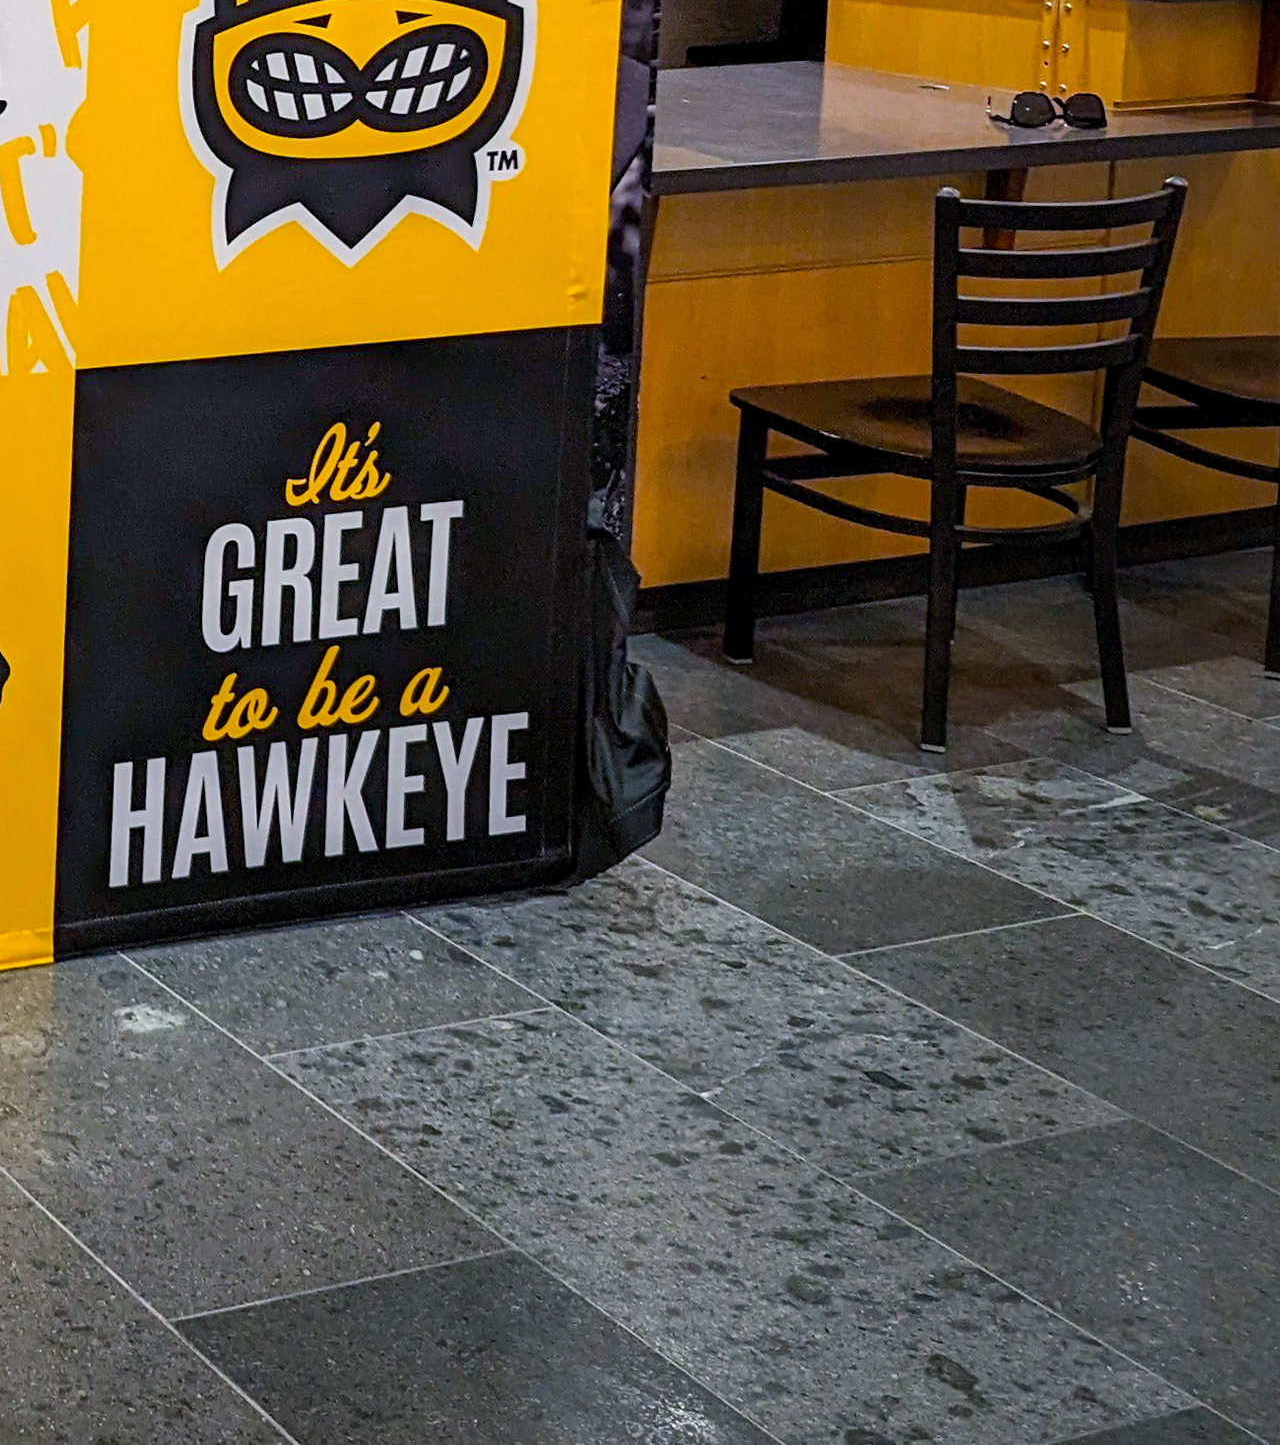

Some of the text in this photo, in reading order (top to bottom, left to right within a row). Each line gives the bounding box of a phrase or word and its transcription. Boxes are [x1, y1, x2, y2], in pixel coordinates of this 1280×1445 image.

[486, 149, 519, 172] TM
[285, 421, 393, 507] It's
[201, 500, 464, 653] GREAT
[202, 645, 450, 742] to be a
[108, 711, 530, 889] HAWKEYE
